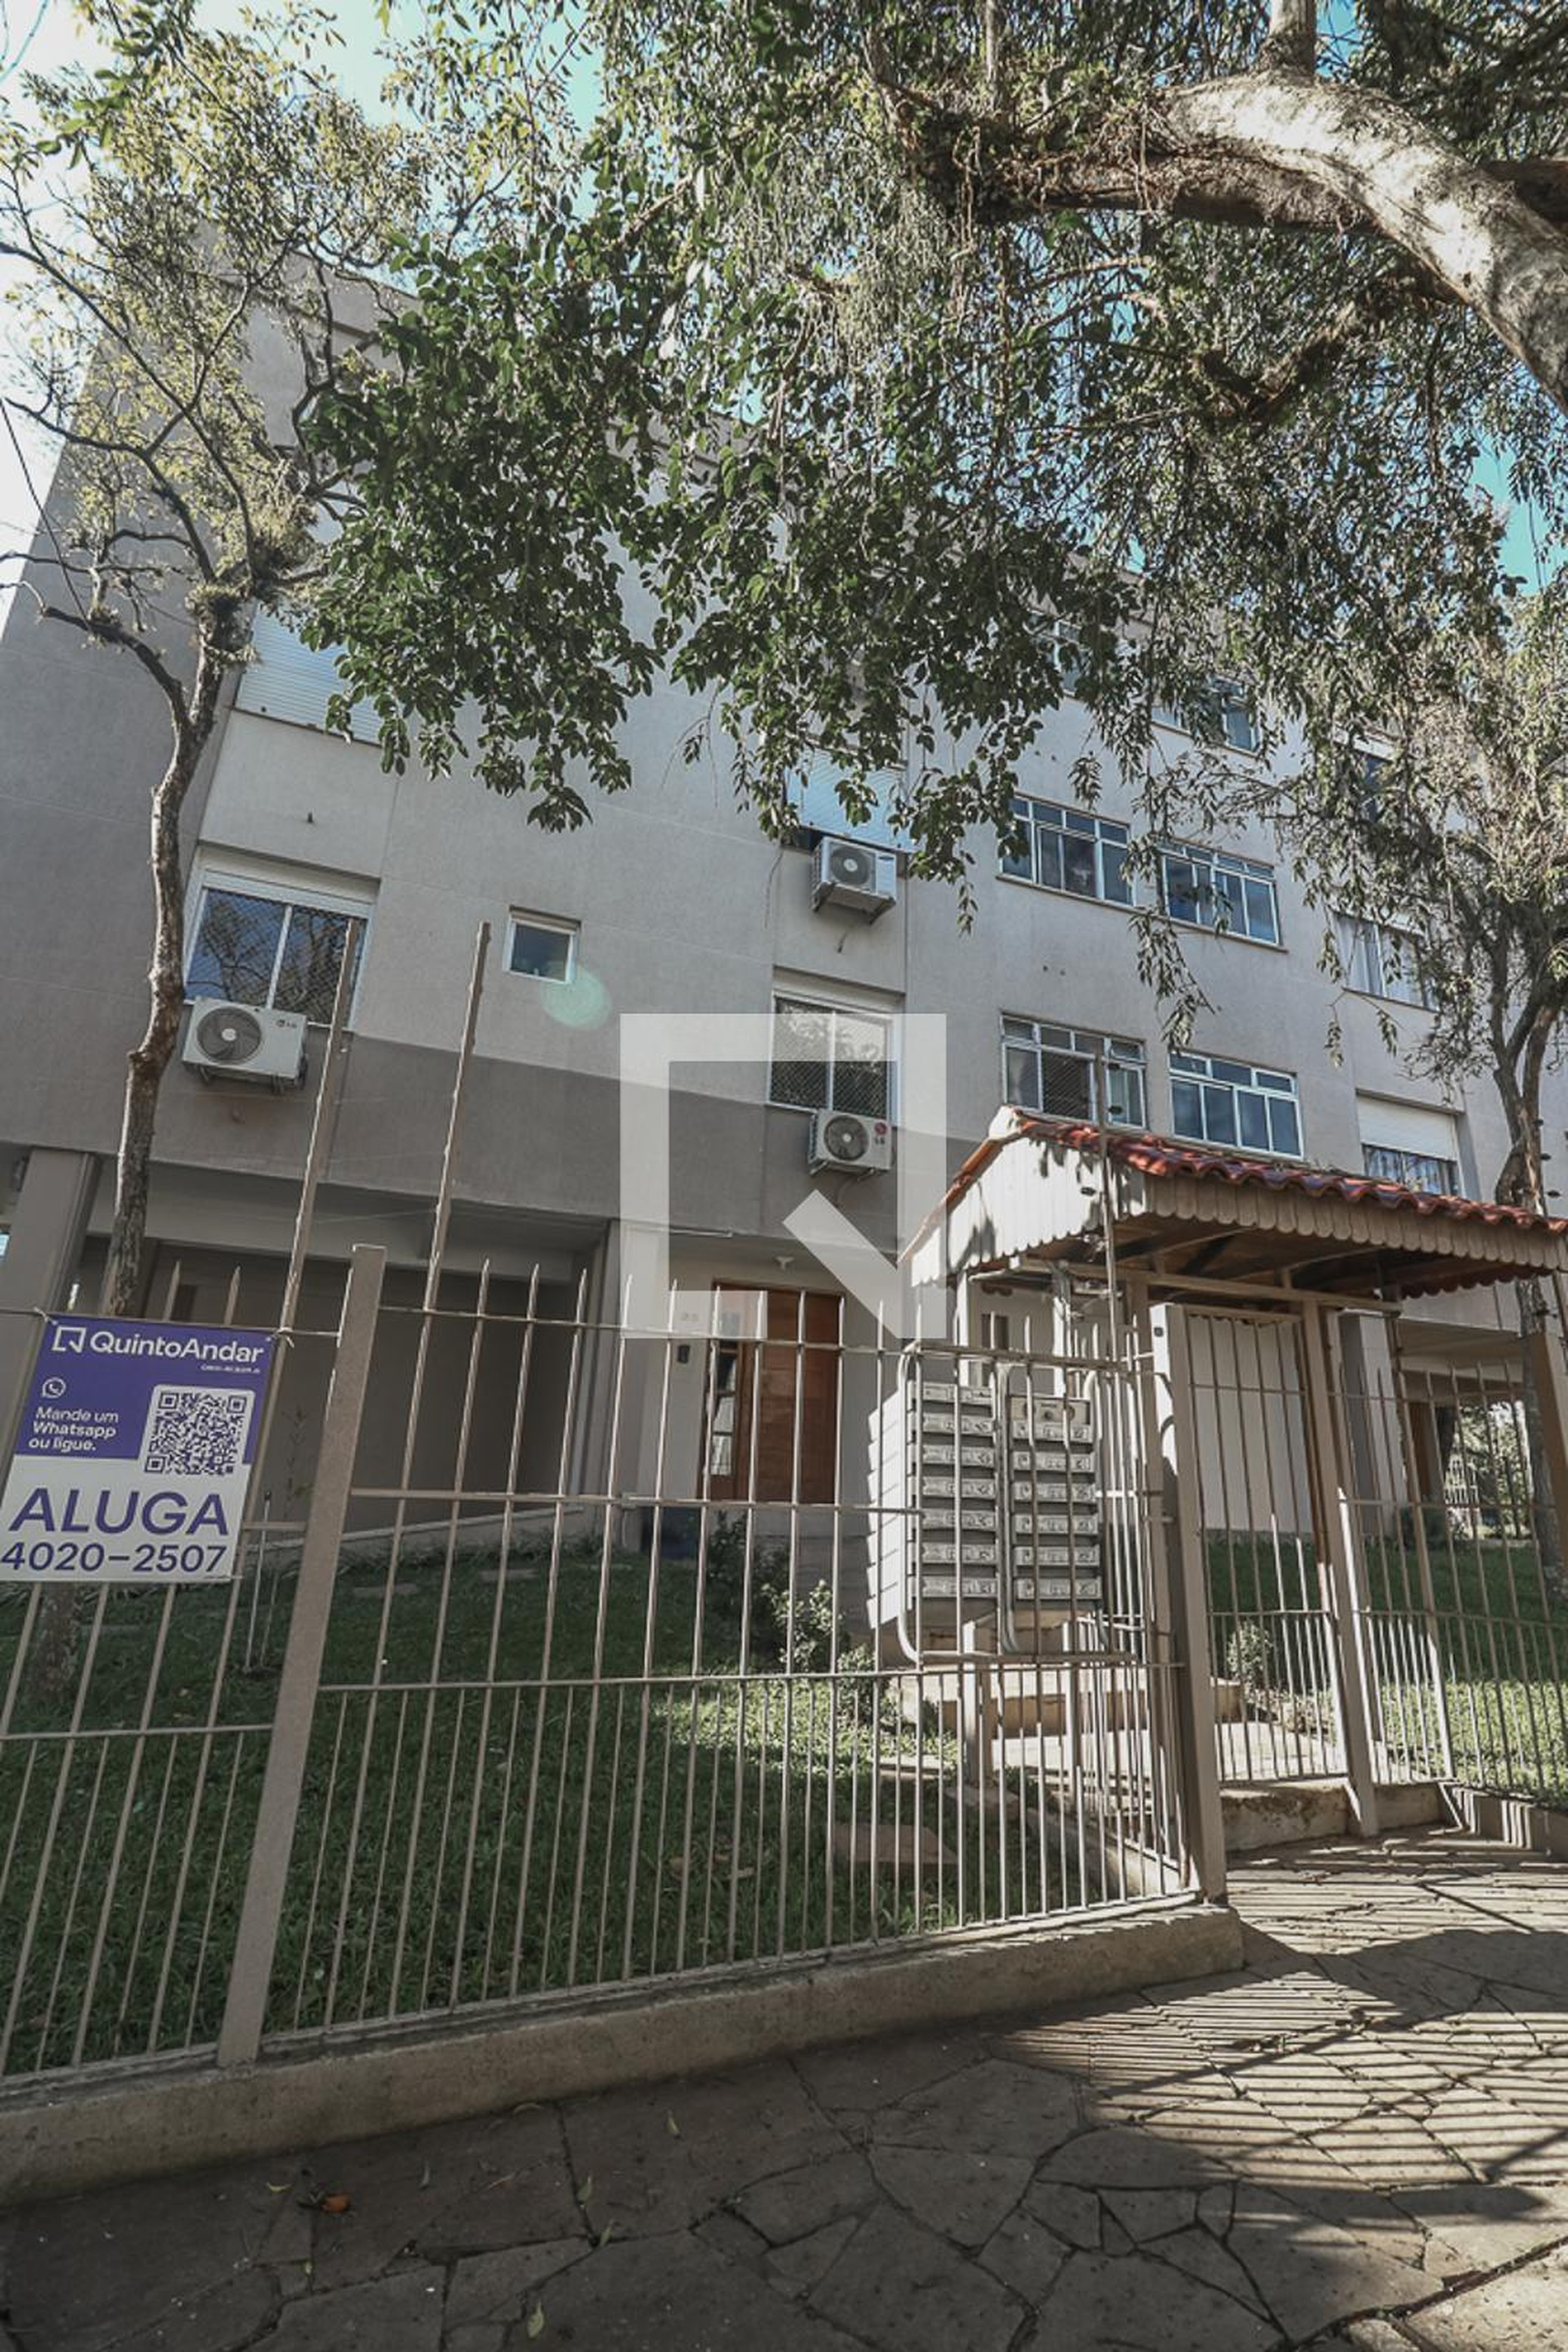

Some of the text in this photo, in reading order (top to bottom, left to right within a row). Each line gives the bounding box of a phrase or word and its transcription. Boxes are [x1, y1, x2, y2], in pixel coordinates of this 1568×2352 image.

[89, 1332, 264, 1363] QuintoAndar
[36, 1406, 119, 1423] Mande um
[33, 1421, 116, 1440] Whatsapp
[29, 1437, 96, 1452] ou ligue.
[8, 1488, 229, 1535] ALUGA
[1, 1542, 227, 1572] 4020-2507
